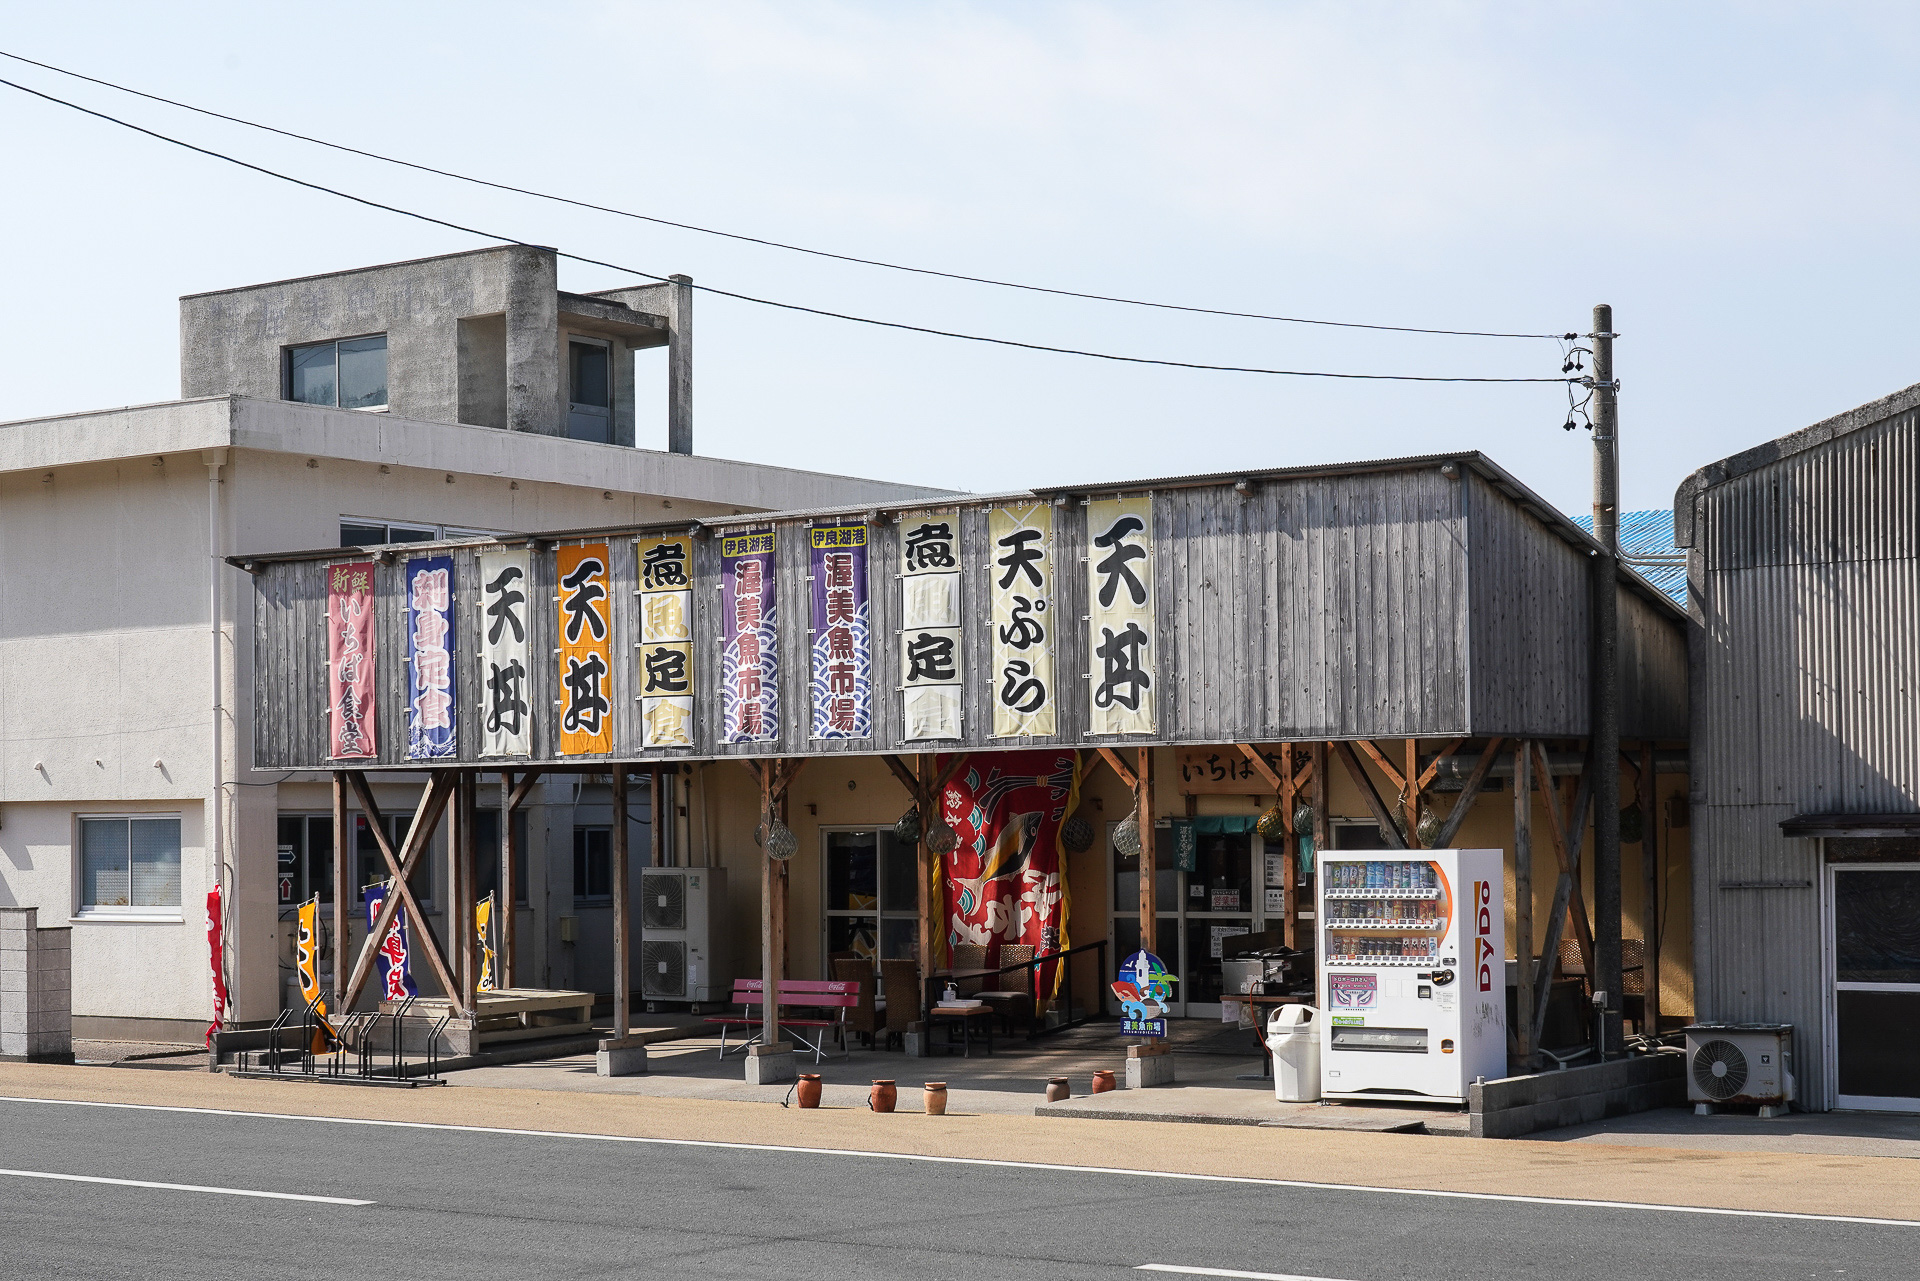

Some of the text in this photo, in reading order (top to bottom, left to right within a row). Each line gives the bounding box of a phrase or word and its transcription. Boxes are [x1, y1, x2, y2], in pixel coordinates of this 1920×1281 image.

[331, 568, 369, 596] 新鮮
[724, 536, 773, 556] 伊良湖港
[813, 529, 865, 547] 伊良湖港
[1094, 517, 1150, 711] 天丼
[336, 598, 363, 755] いちば食堂
[413, 569, 452, 728] 刺身定食
[486, 566, 527, 736] 天丼
[562, 560, 608, 735] 天丼
[643, 542, 691, 744] 煮魚定食
[736, 560, 763, 735] 渥美魚市場
[826, 553, 855, 732] 渥美魚市場
[998, 529, 1046, 713] 天ぷら
[1213, 895, 1238, 906] 営業中
[828, 983, 846, 991] Coca-Cola
[1123, 1020, 1161, 1032] 渥美魚市場
